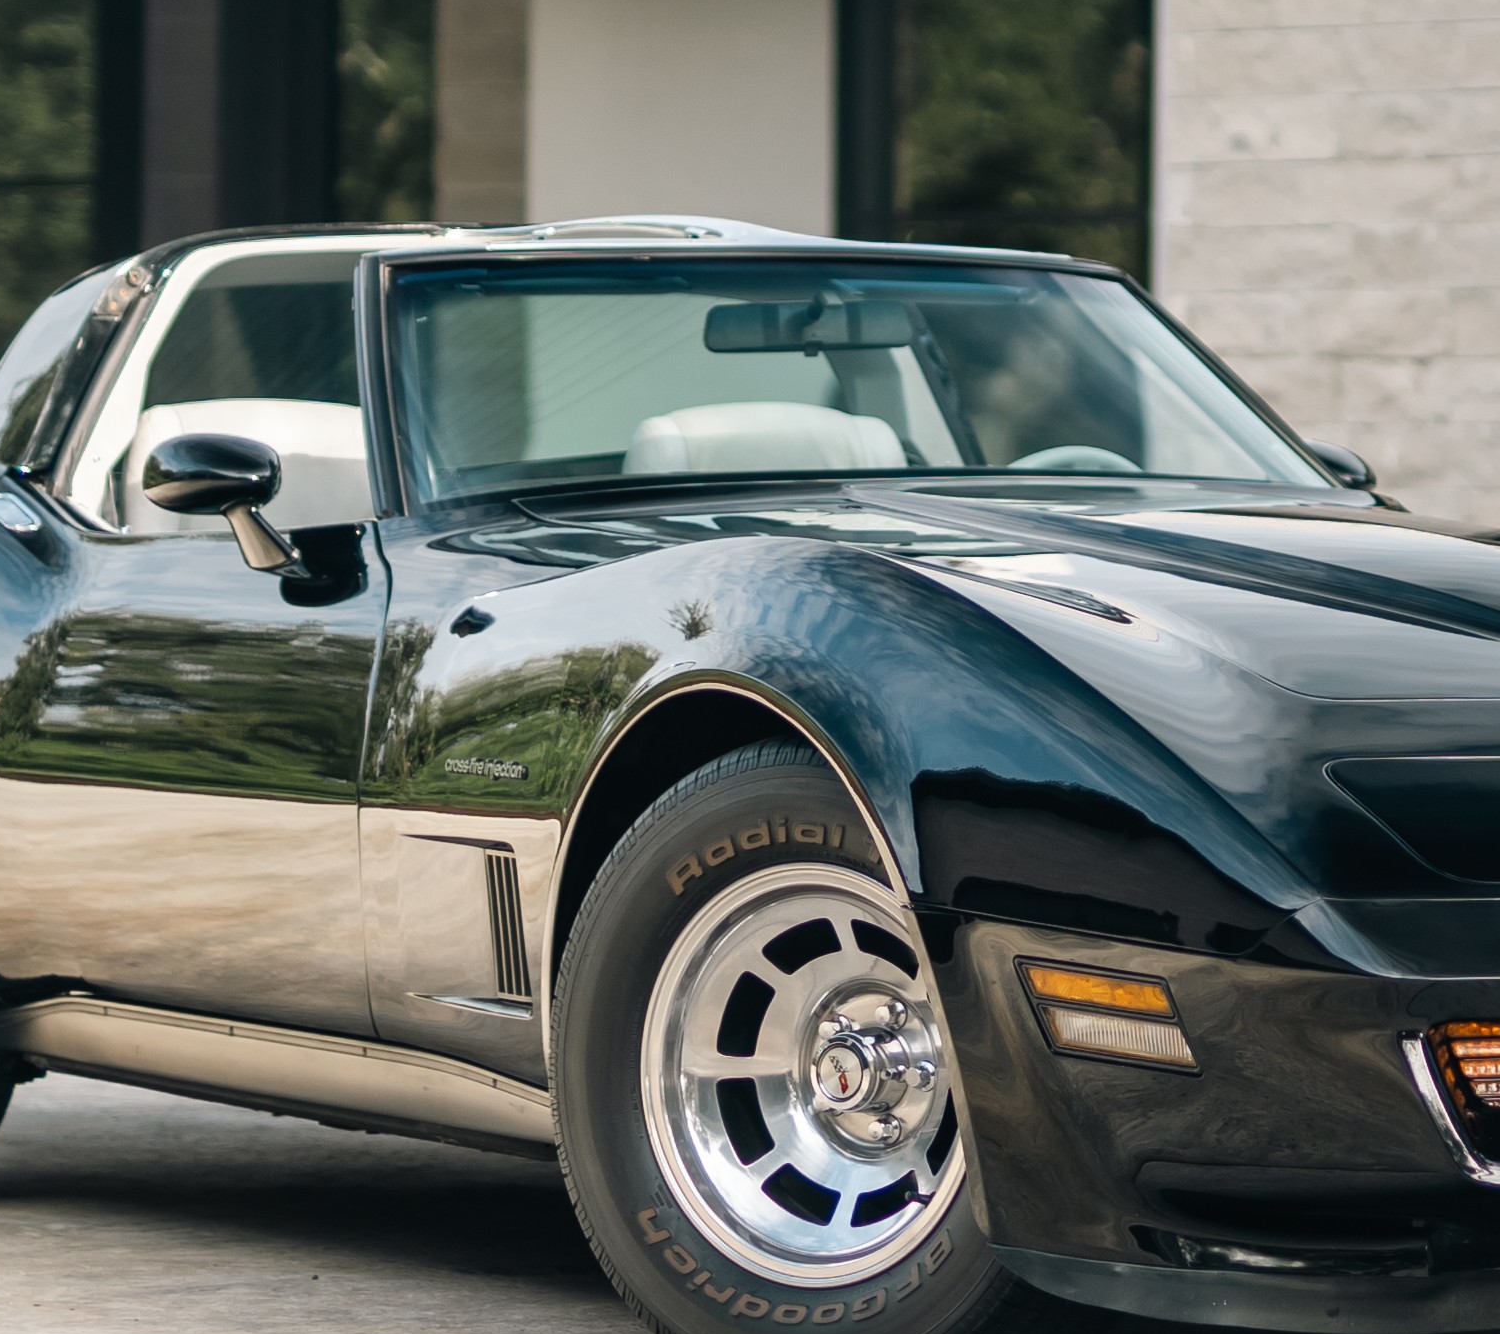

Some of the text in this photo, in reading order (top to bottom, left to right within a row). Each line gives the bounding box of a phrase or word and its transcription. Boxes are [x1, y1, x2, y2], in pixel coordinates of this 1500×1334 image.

[484, 758, 522, 781] injection
[666, 817, 844, 896] Radial
[637, 1207, 955, 1325] BFGoodrich
